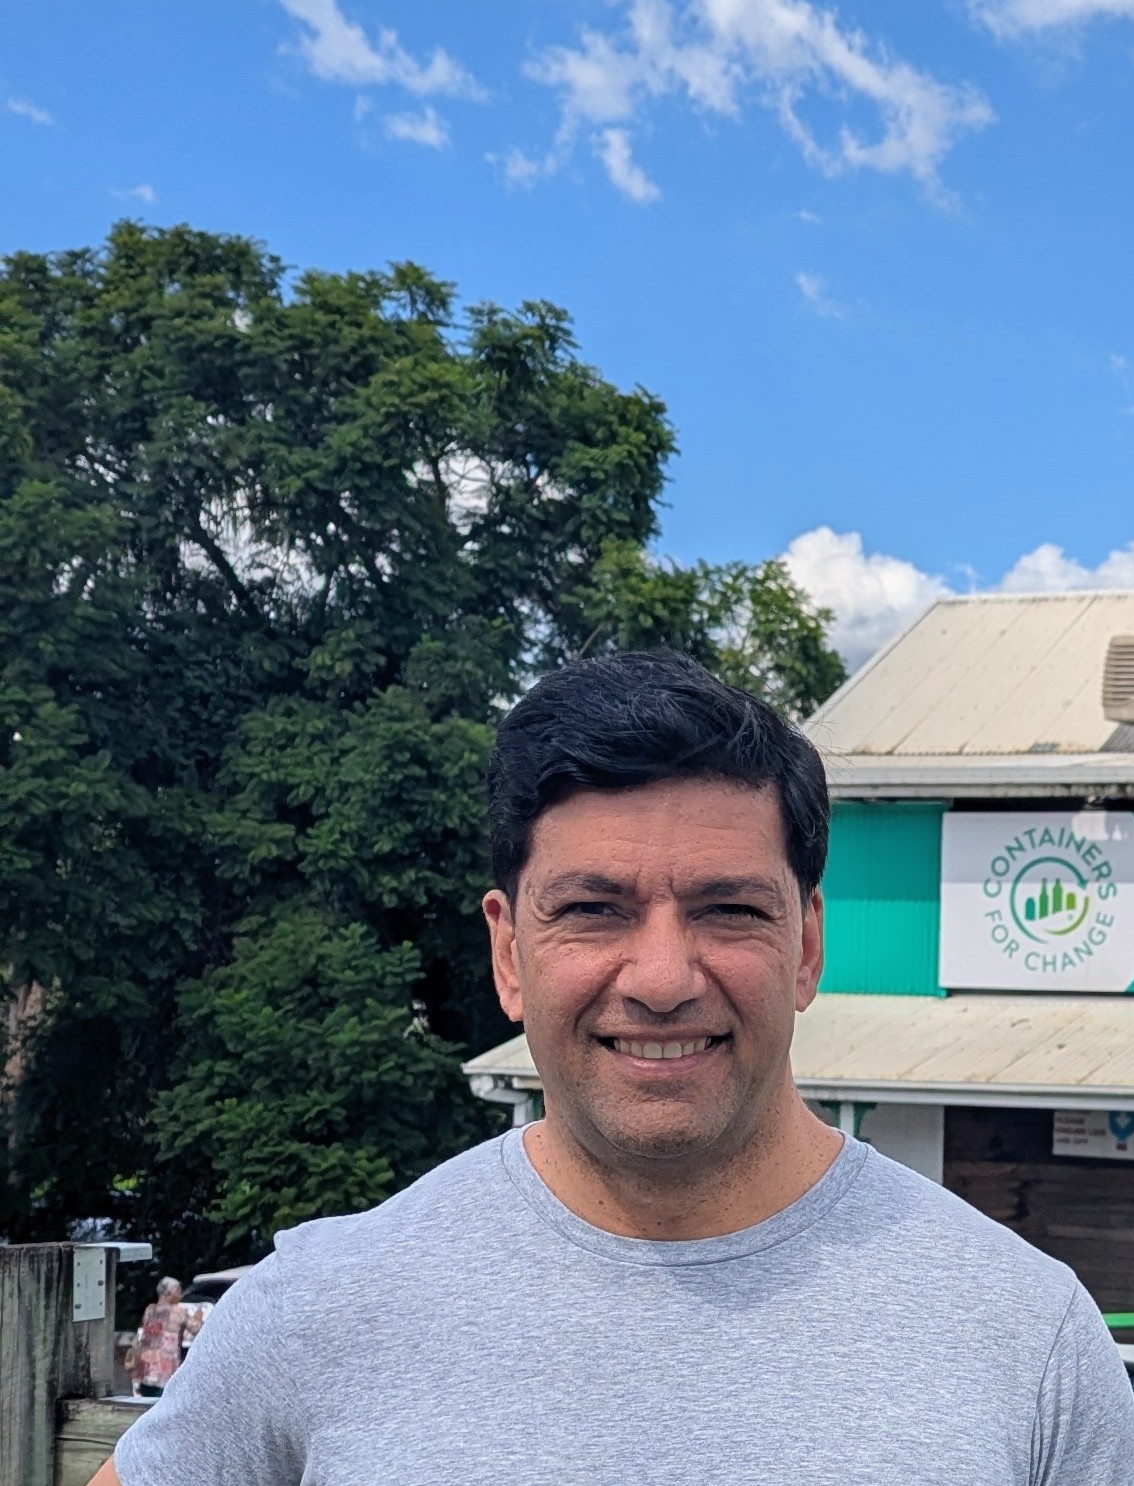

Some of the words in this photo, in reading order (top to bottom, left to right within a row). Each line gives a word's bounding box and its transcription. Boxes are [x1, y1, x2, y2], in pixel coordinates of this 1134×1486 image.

[983, 827, 1117, 900] CONTAINERS
[984, 909, 1020, 959] FOR
[1024, 912, 1115, 973] CHANGE
